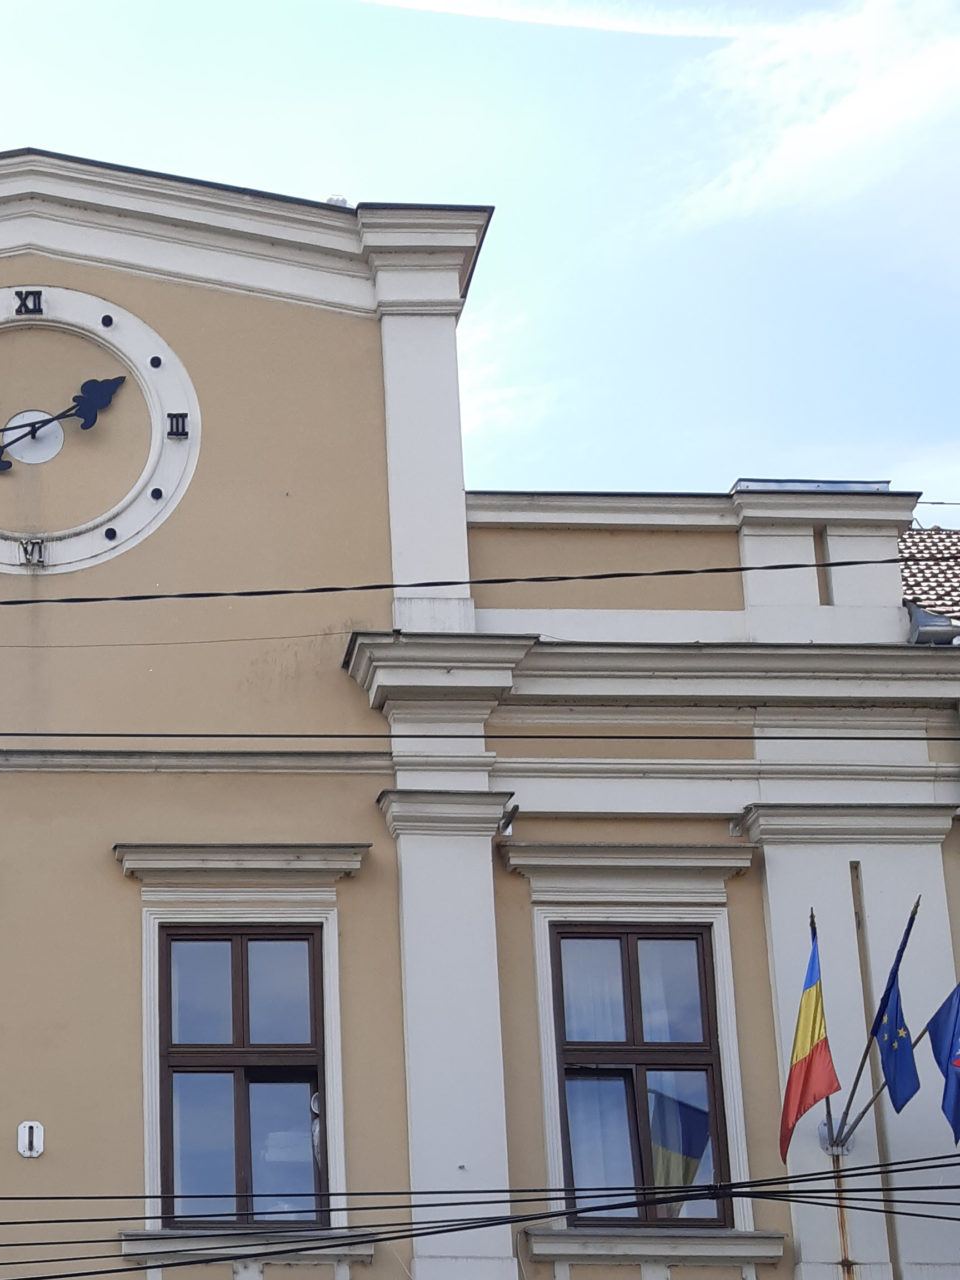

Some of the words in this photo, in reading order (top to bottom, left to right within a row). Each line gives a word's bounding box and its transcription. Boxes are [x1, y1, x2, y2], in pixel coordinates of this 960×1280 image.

[15, 290, 43, 316] XII
[167, 412, 189, 440] III
[19, 539, 45, 567] VI
